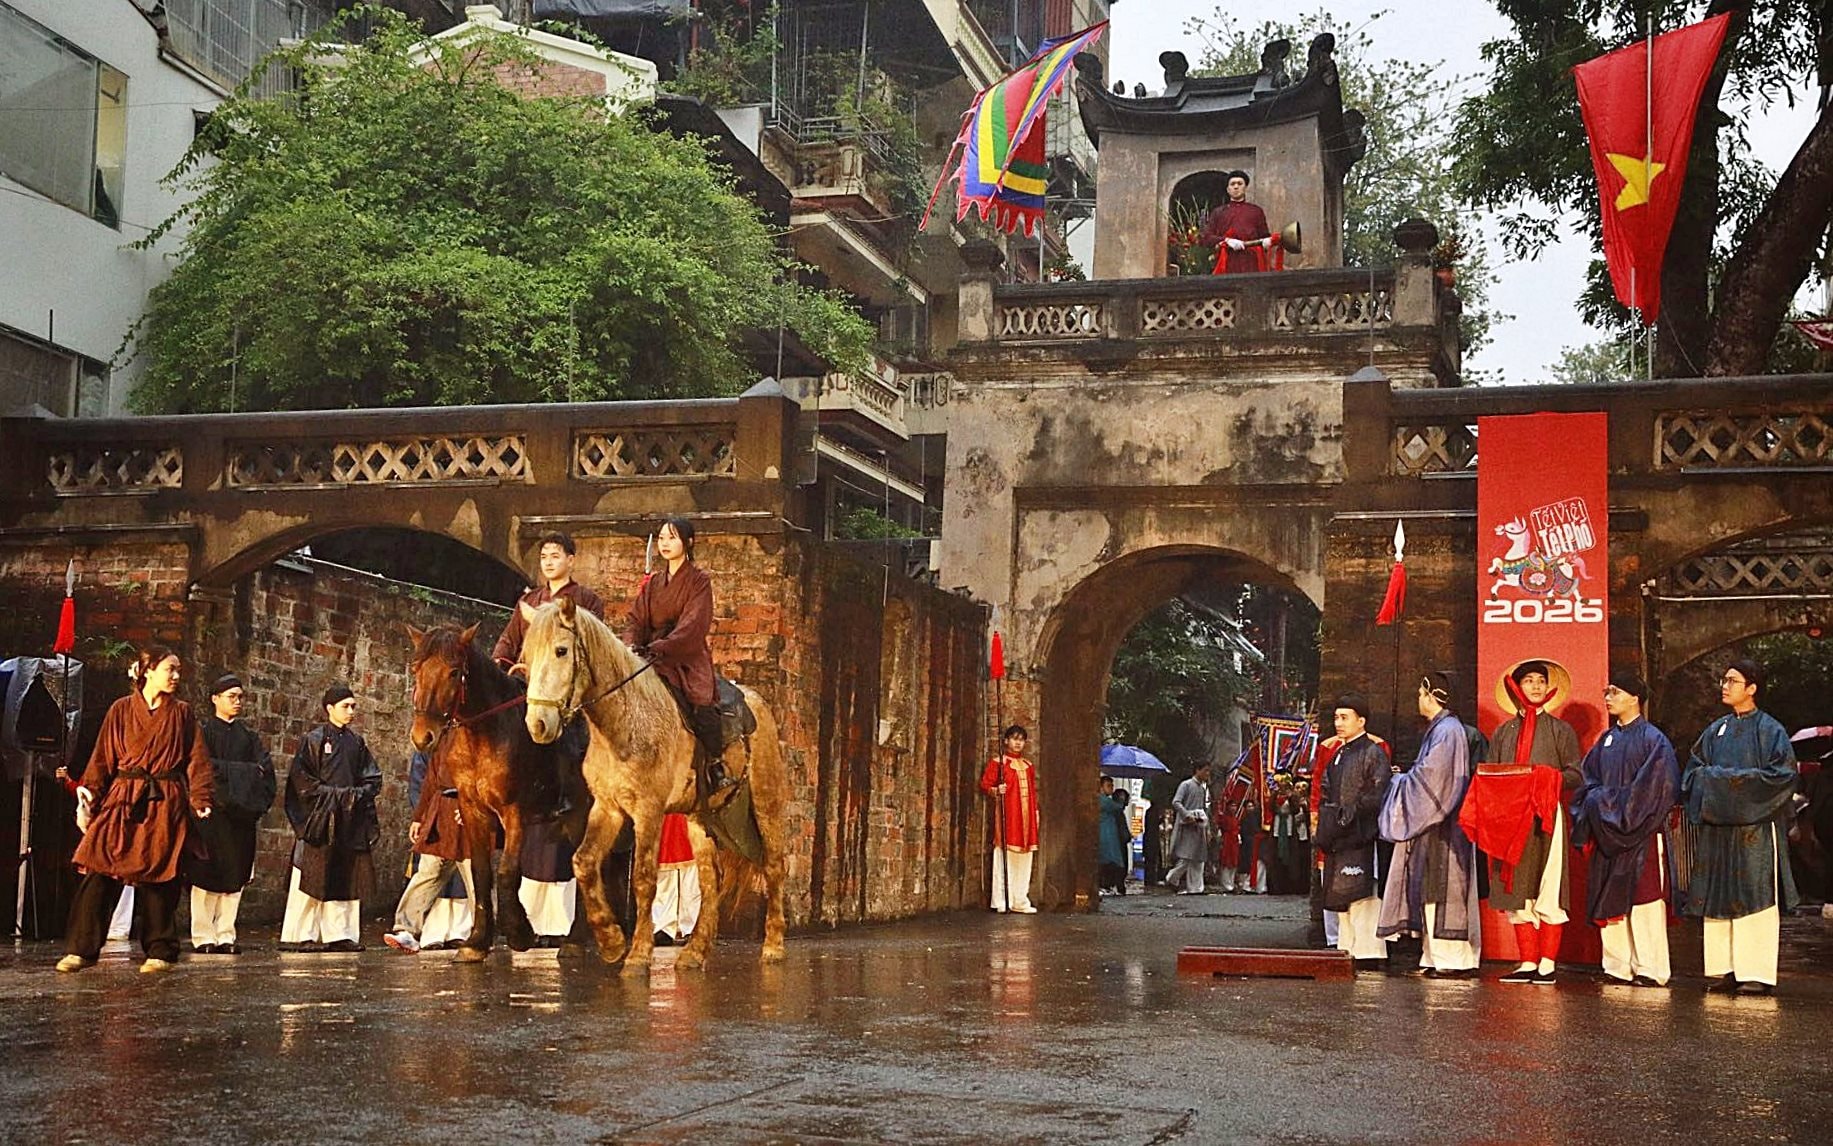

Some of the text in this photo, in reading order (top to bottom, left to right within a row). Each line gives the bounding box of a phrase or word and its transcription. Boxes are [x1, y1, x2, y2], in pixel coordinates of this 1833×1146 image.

[1538, 517, 1593, 558] Tết Phố
[1484, 599, 1603, 623] 2026
